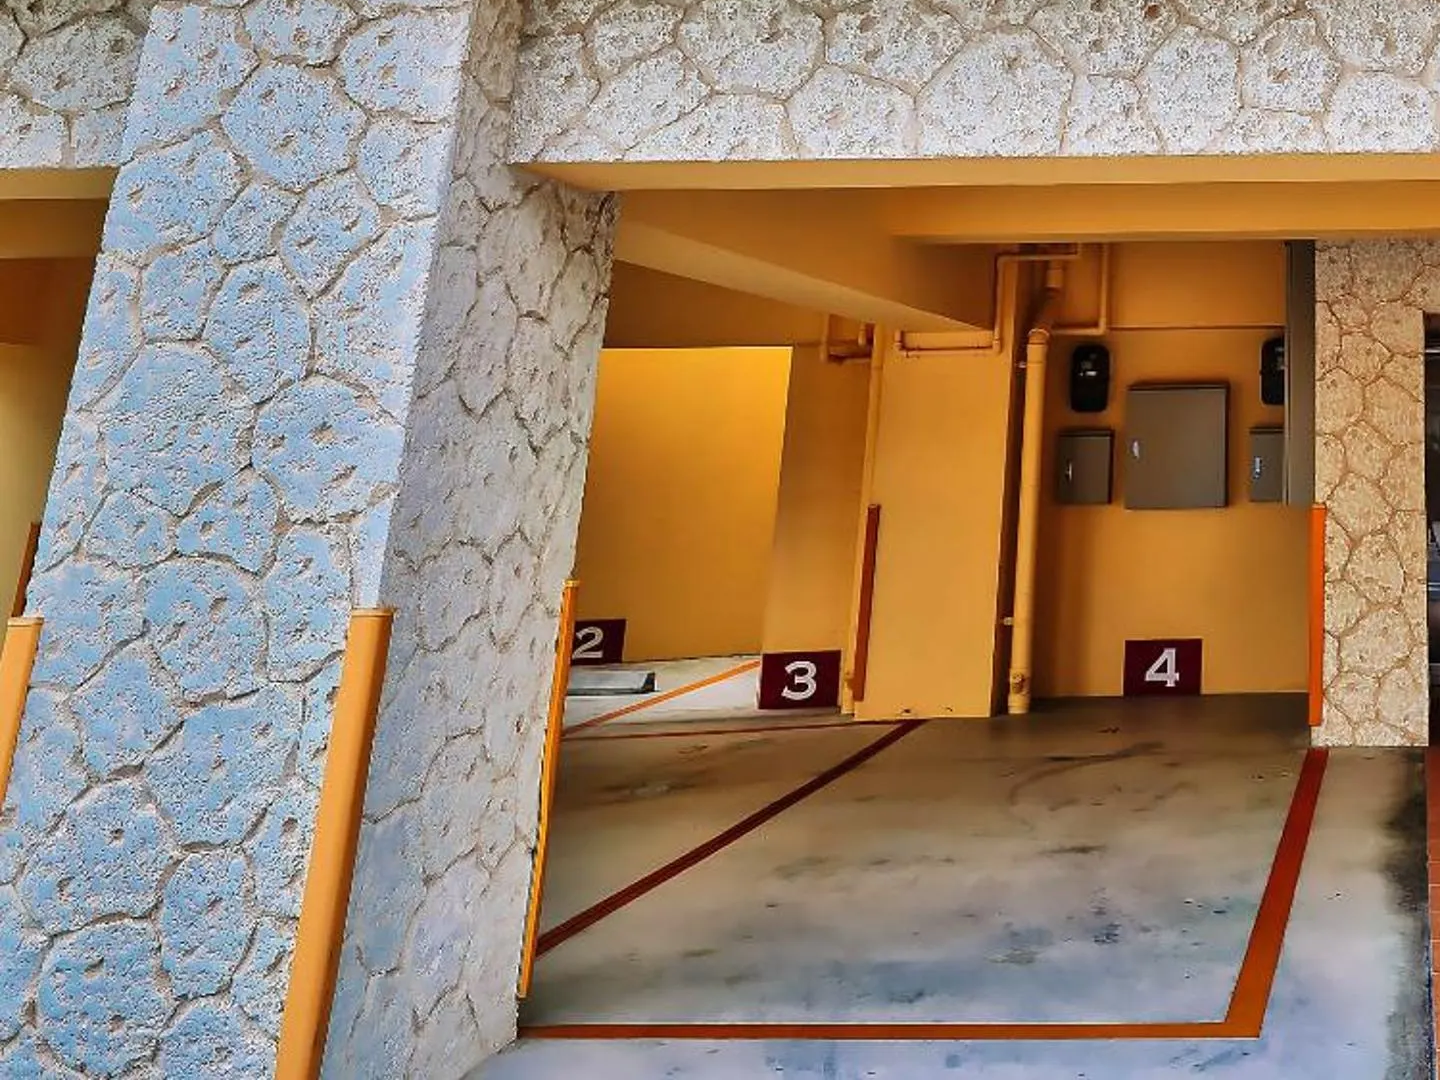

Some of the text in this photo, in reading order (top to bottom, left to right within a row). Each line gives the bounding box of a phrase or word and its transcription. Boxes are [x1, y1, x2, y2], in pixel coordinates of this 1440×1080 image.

[573, 625, 604, 659] 2
[780, 660, 818, 701] 3
[1144, 647, 1180, 688] 4
